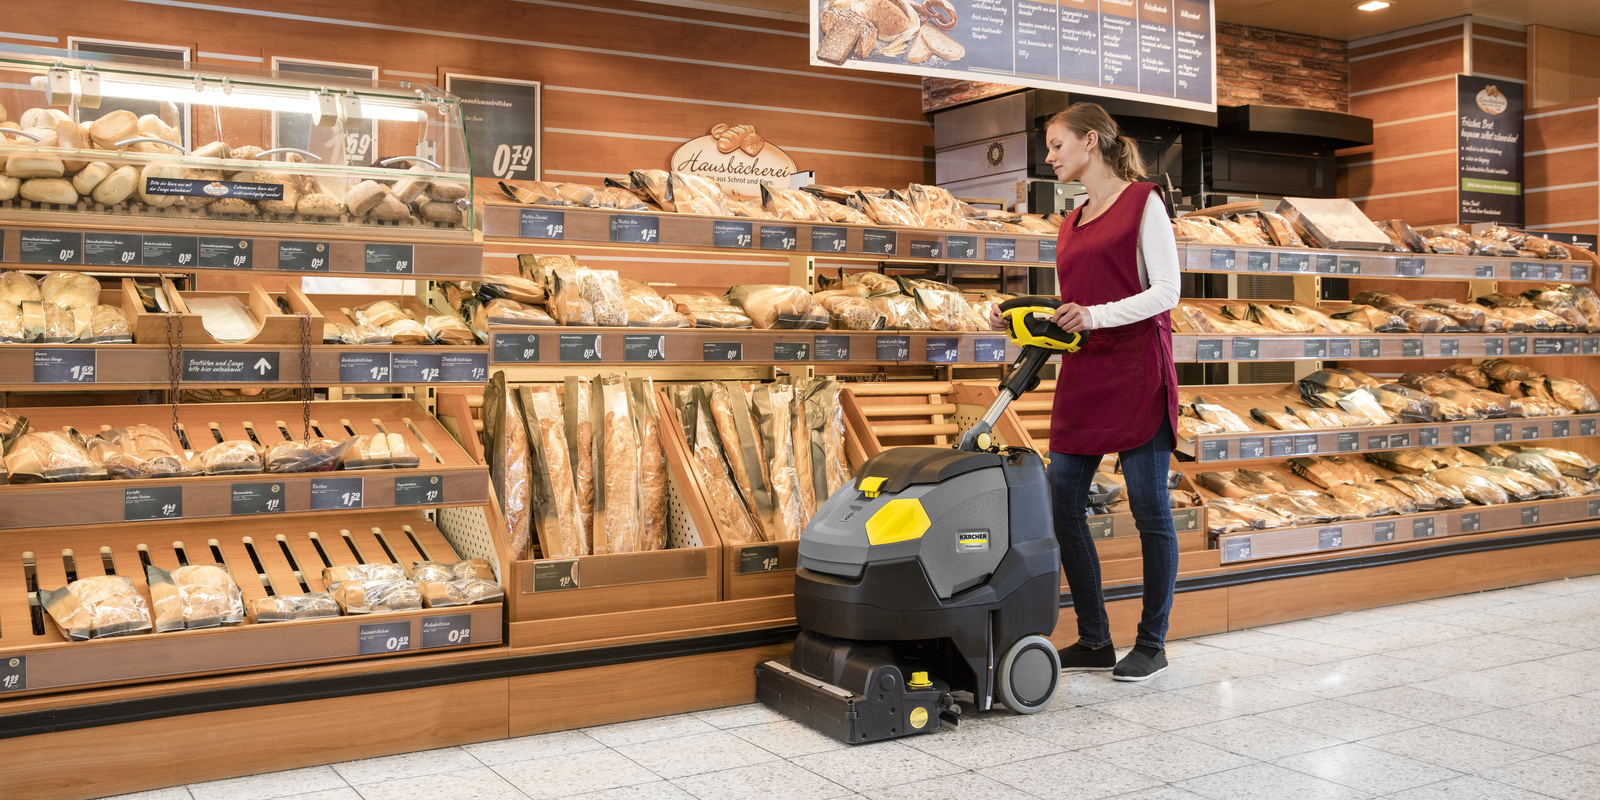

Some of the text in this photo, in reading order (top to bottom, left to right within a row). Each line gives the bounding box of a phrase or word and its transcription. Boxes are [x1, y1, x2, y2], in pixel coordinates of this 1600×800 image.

[460, 98, 513, 107] nnenblumenbrötchen
[492, 143, 533, 179] 0,79
[678, 150, 791, 178] Hausbäckerei
[728, 176, 746, 184] Schrot
[546, 224, 563, 237] 1,49
[641, 229, 657, 242] 1,49
[60, 249, 74, 261] 0,25
[121, 252, 136, 263] 0,25
[227, 360, 244, 368] Zange
[70, 366, 94, 381] 1,69
[370, 366, 389, 381] 1,19
[421, 368, 439, 382] 1,39
[342, 492, 361, 507] 1,29
[763, 557, 778, 570] 1,49
[448, 628, 470, 643] 0,49
[386, 636, 409, 651] 0,49
